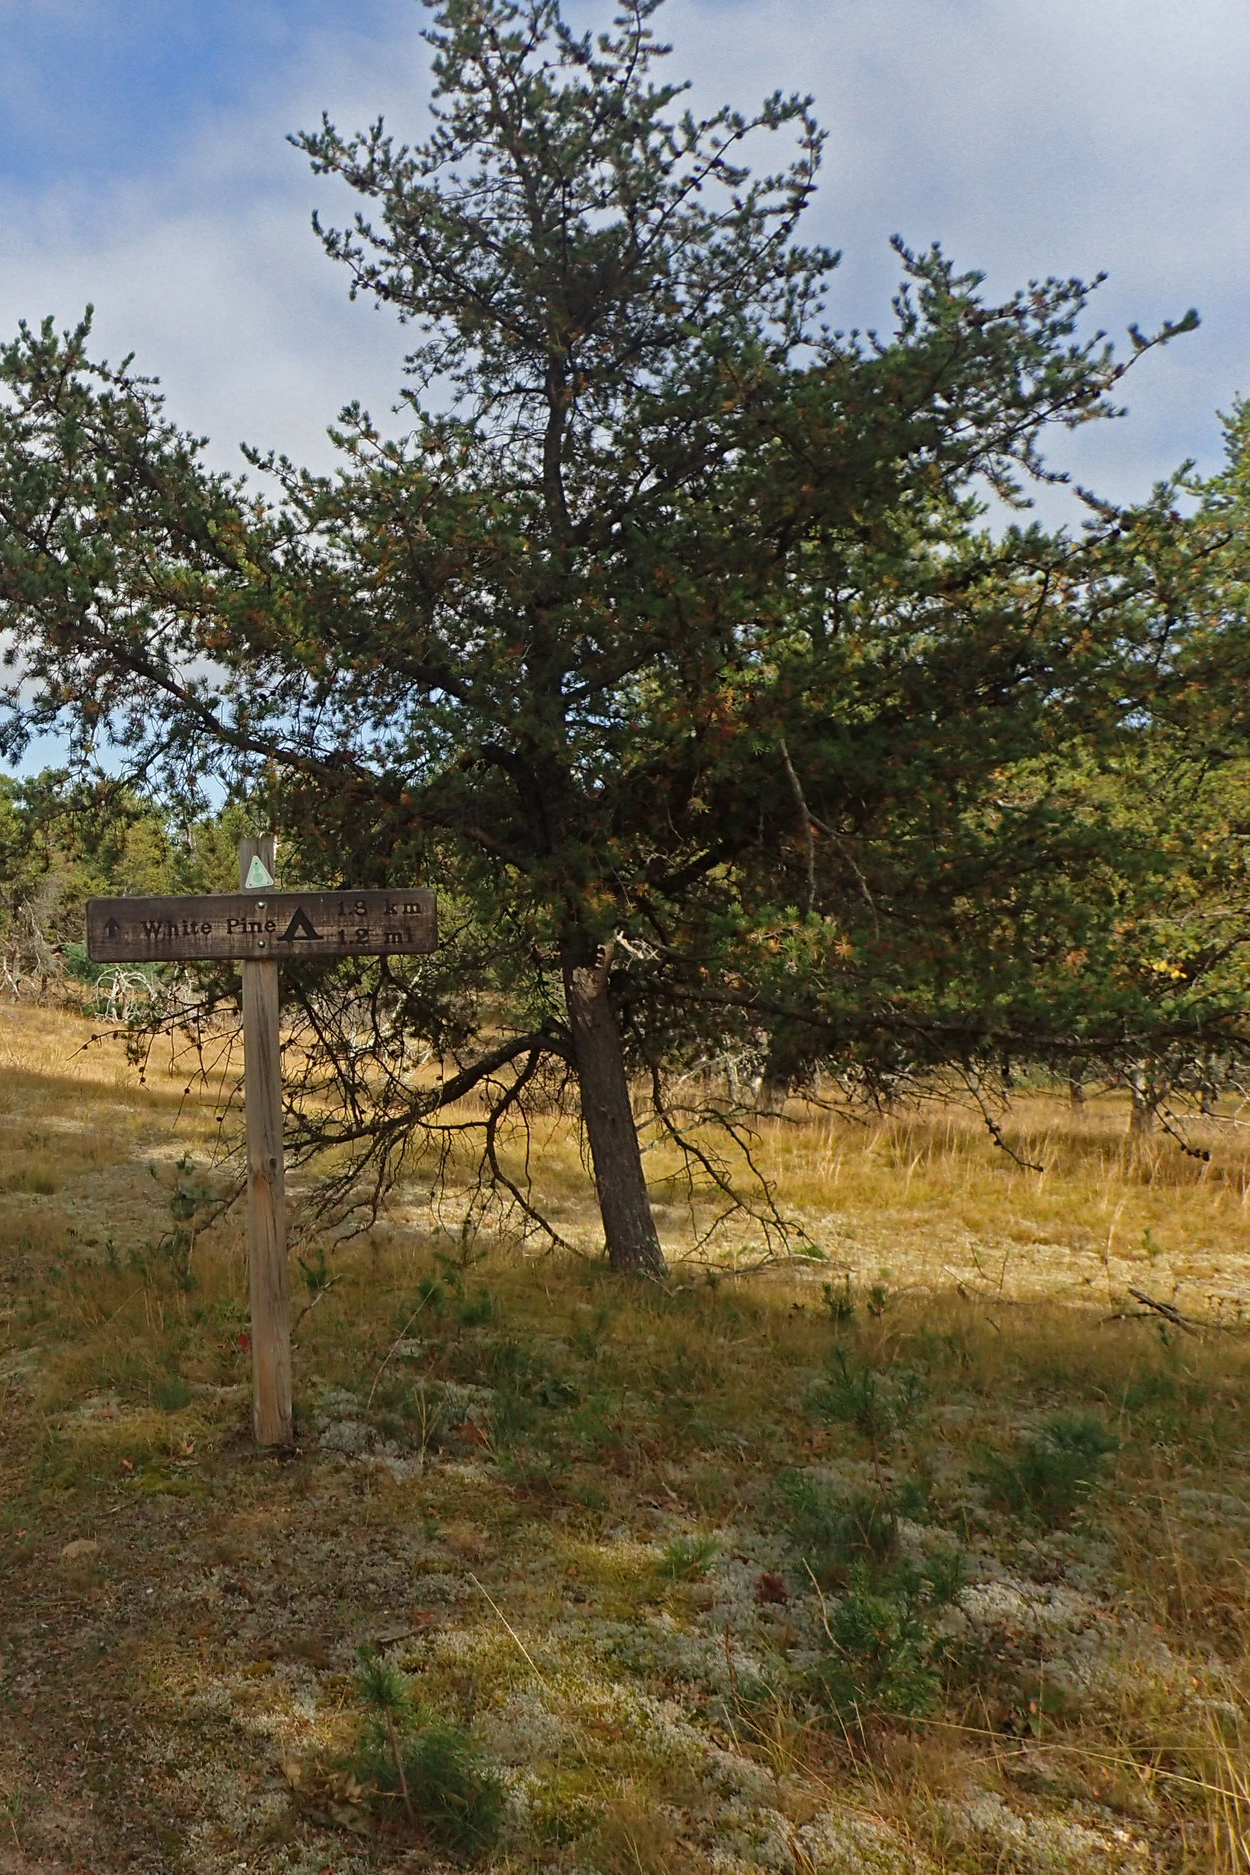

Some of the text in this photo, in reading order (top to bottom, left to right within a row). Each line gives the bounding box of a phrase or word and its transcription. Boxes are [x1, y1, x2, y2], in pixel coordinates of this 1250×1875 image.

[338, 899, 422, 916] 1.8 km
[142, 919, 276, 937] White Pine
[338, 927, 414, 945] 1.2 mi
